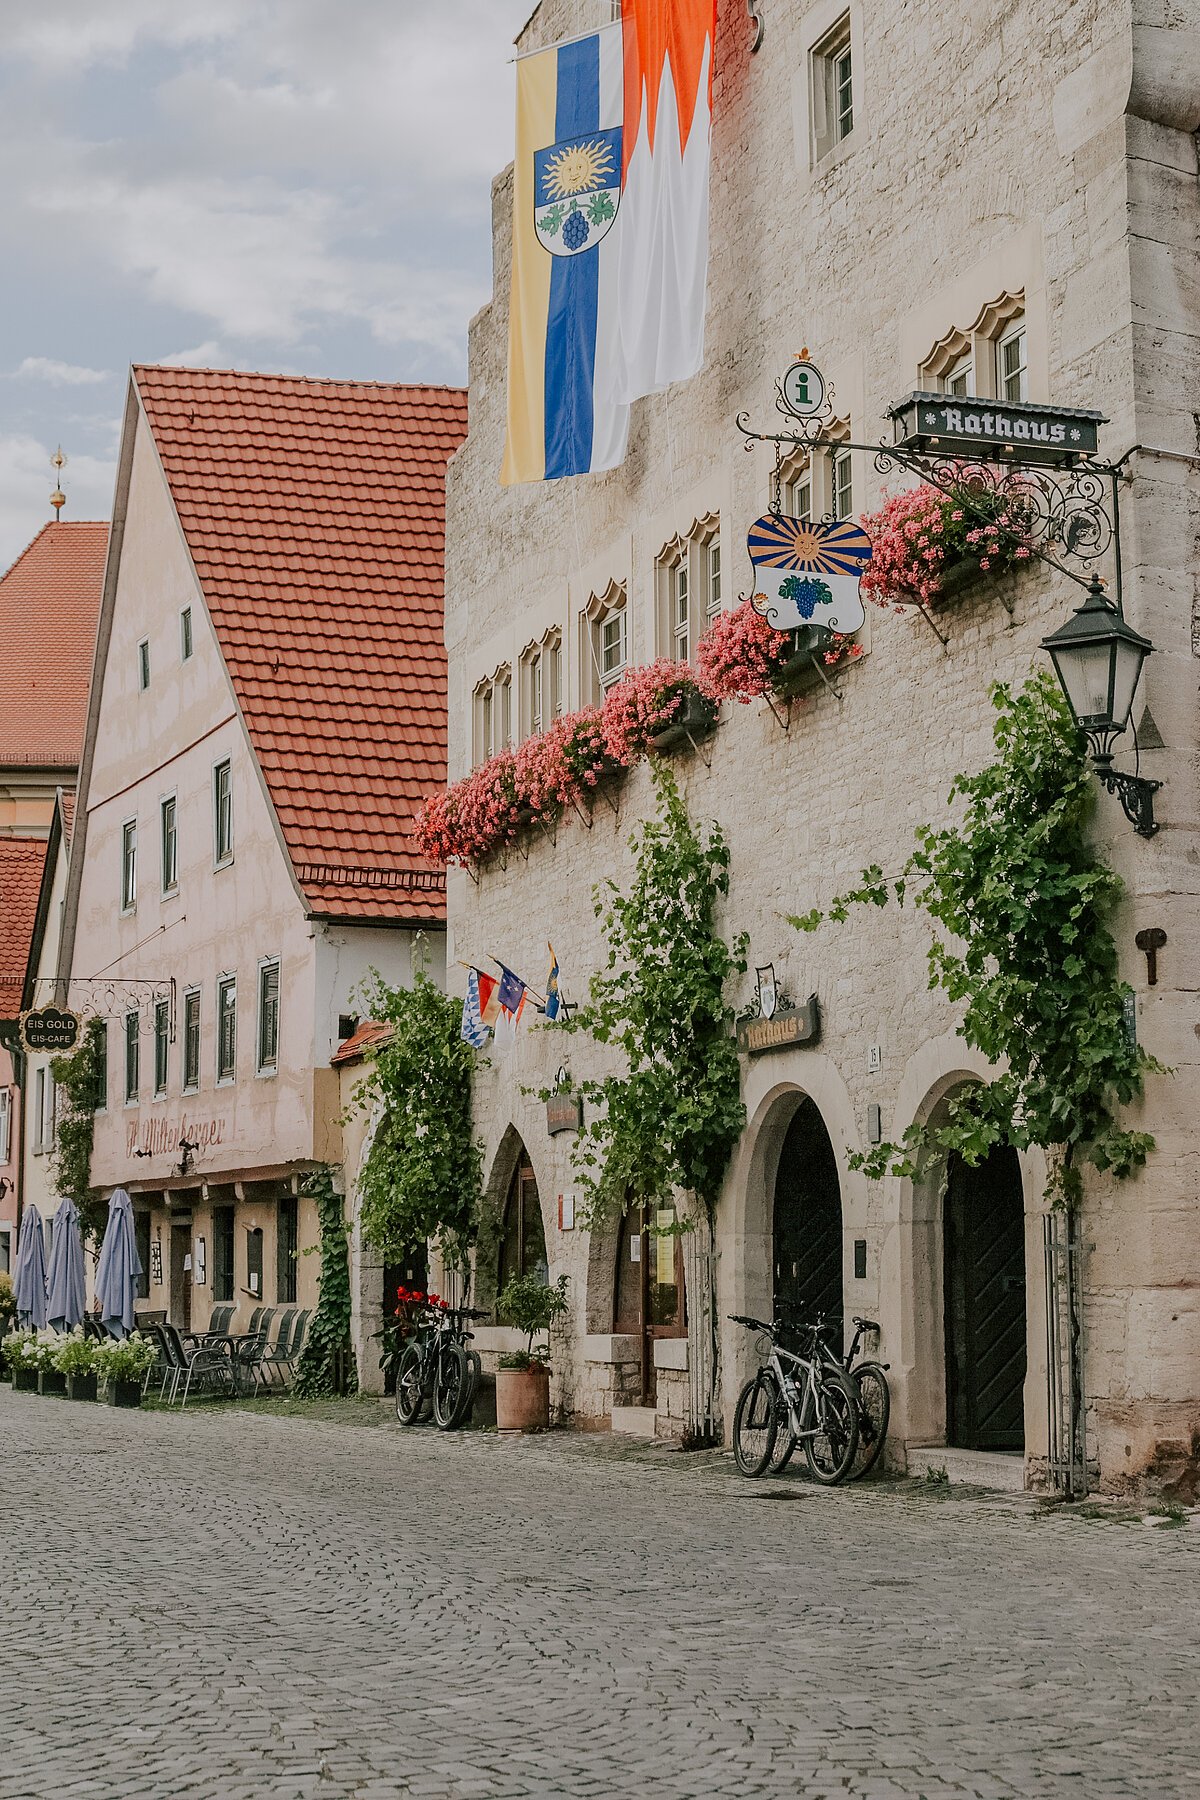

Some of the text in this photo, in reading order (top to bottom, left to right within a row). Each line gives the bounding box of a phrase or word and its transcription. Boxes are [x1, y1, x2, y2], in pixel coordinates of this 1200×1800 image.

[940, 406, 1066, 443] Rathaus
[27, 1019, 75, 1030] EIS GOLD
[31, 1034, 71, 1043] EIS-CAFE
